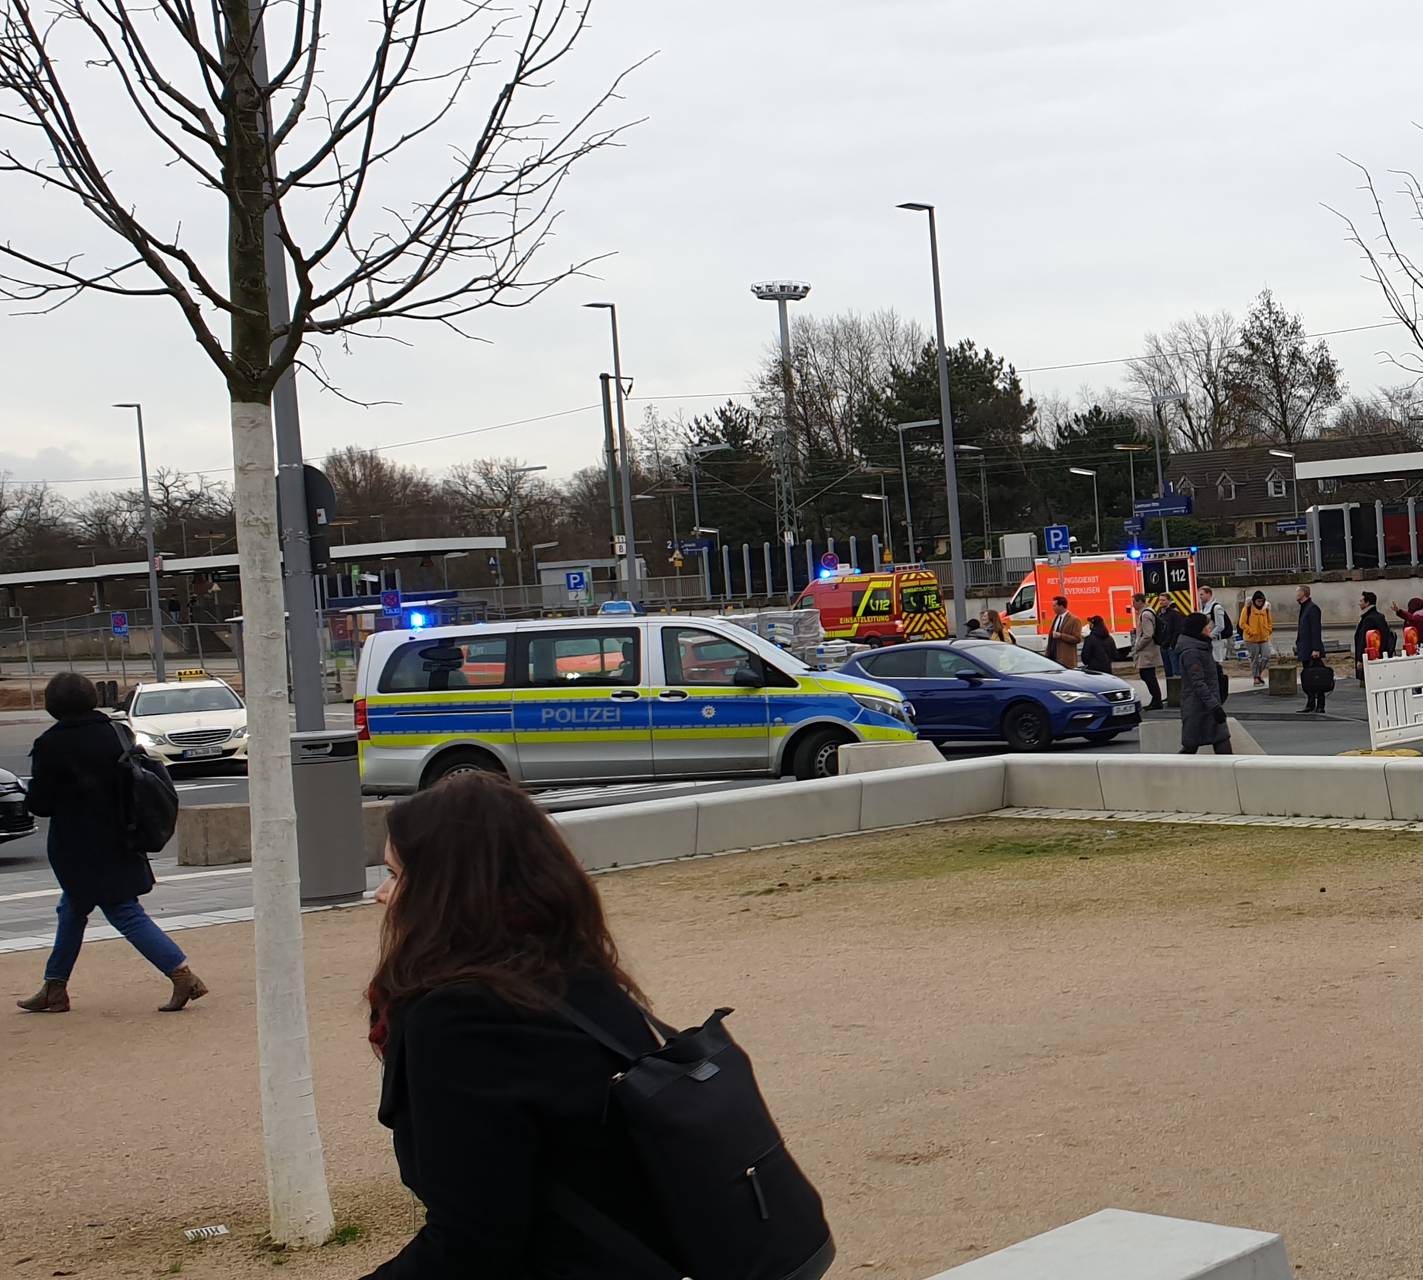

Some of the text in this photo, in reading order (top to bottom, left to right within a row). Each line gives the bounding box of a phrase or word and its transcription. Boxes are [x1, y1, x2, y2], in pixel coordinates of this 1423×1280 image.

[666, 540, 673, 549] 2
[1050, 529, 1063, 549] P
[489, 556, 496, 565] A
[1170, 568, 1186, 582] 112
[569, 574, 581, 588] P
[1064, 586, 1100, 595] EVERKUSEN
[924, 594, 937, 605] 112
[875, 600, 891, 611] 112
[840, 615, 890, 624] EINSATZLEITUNG
[541, 706, 621, 724] POLIZEI
